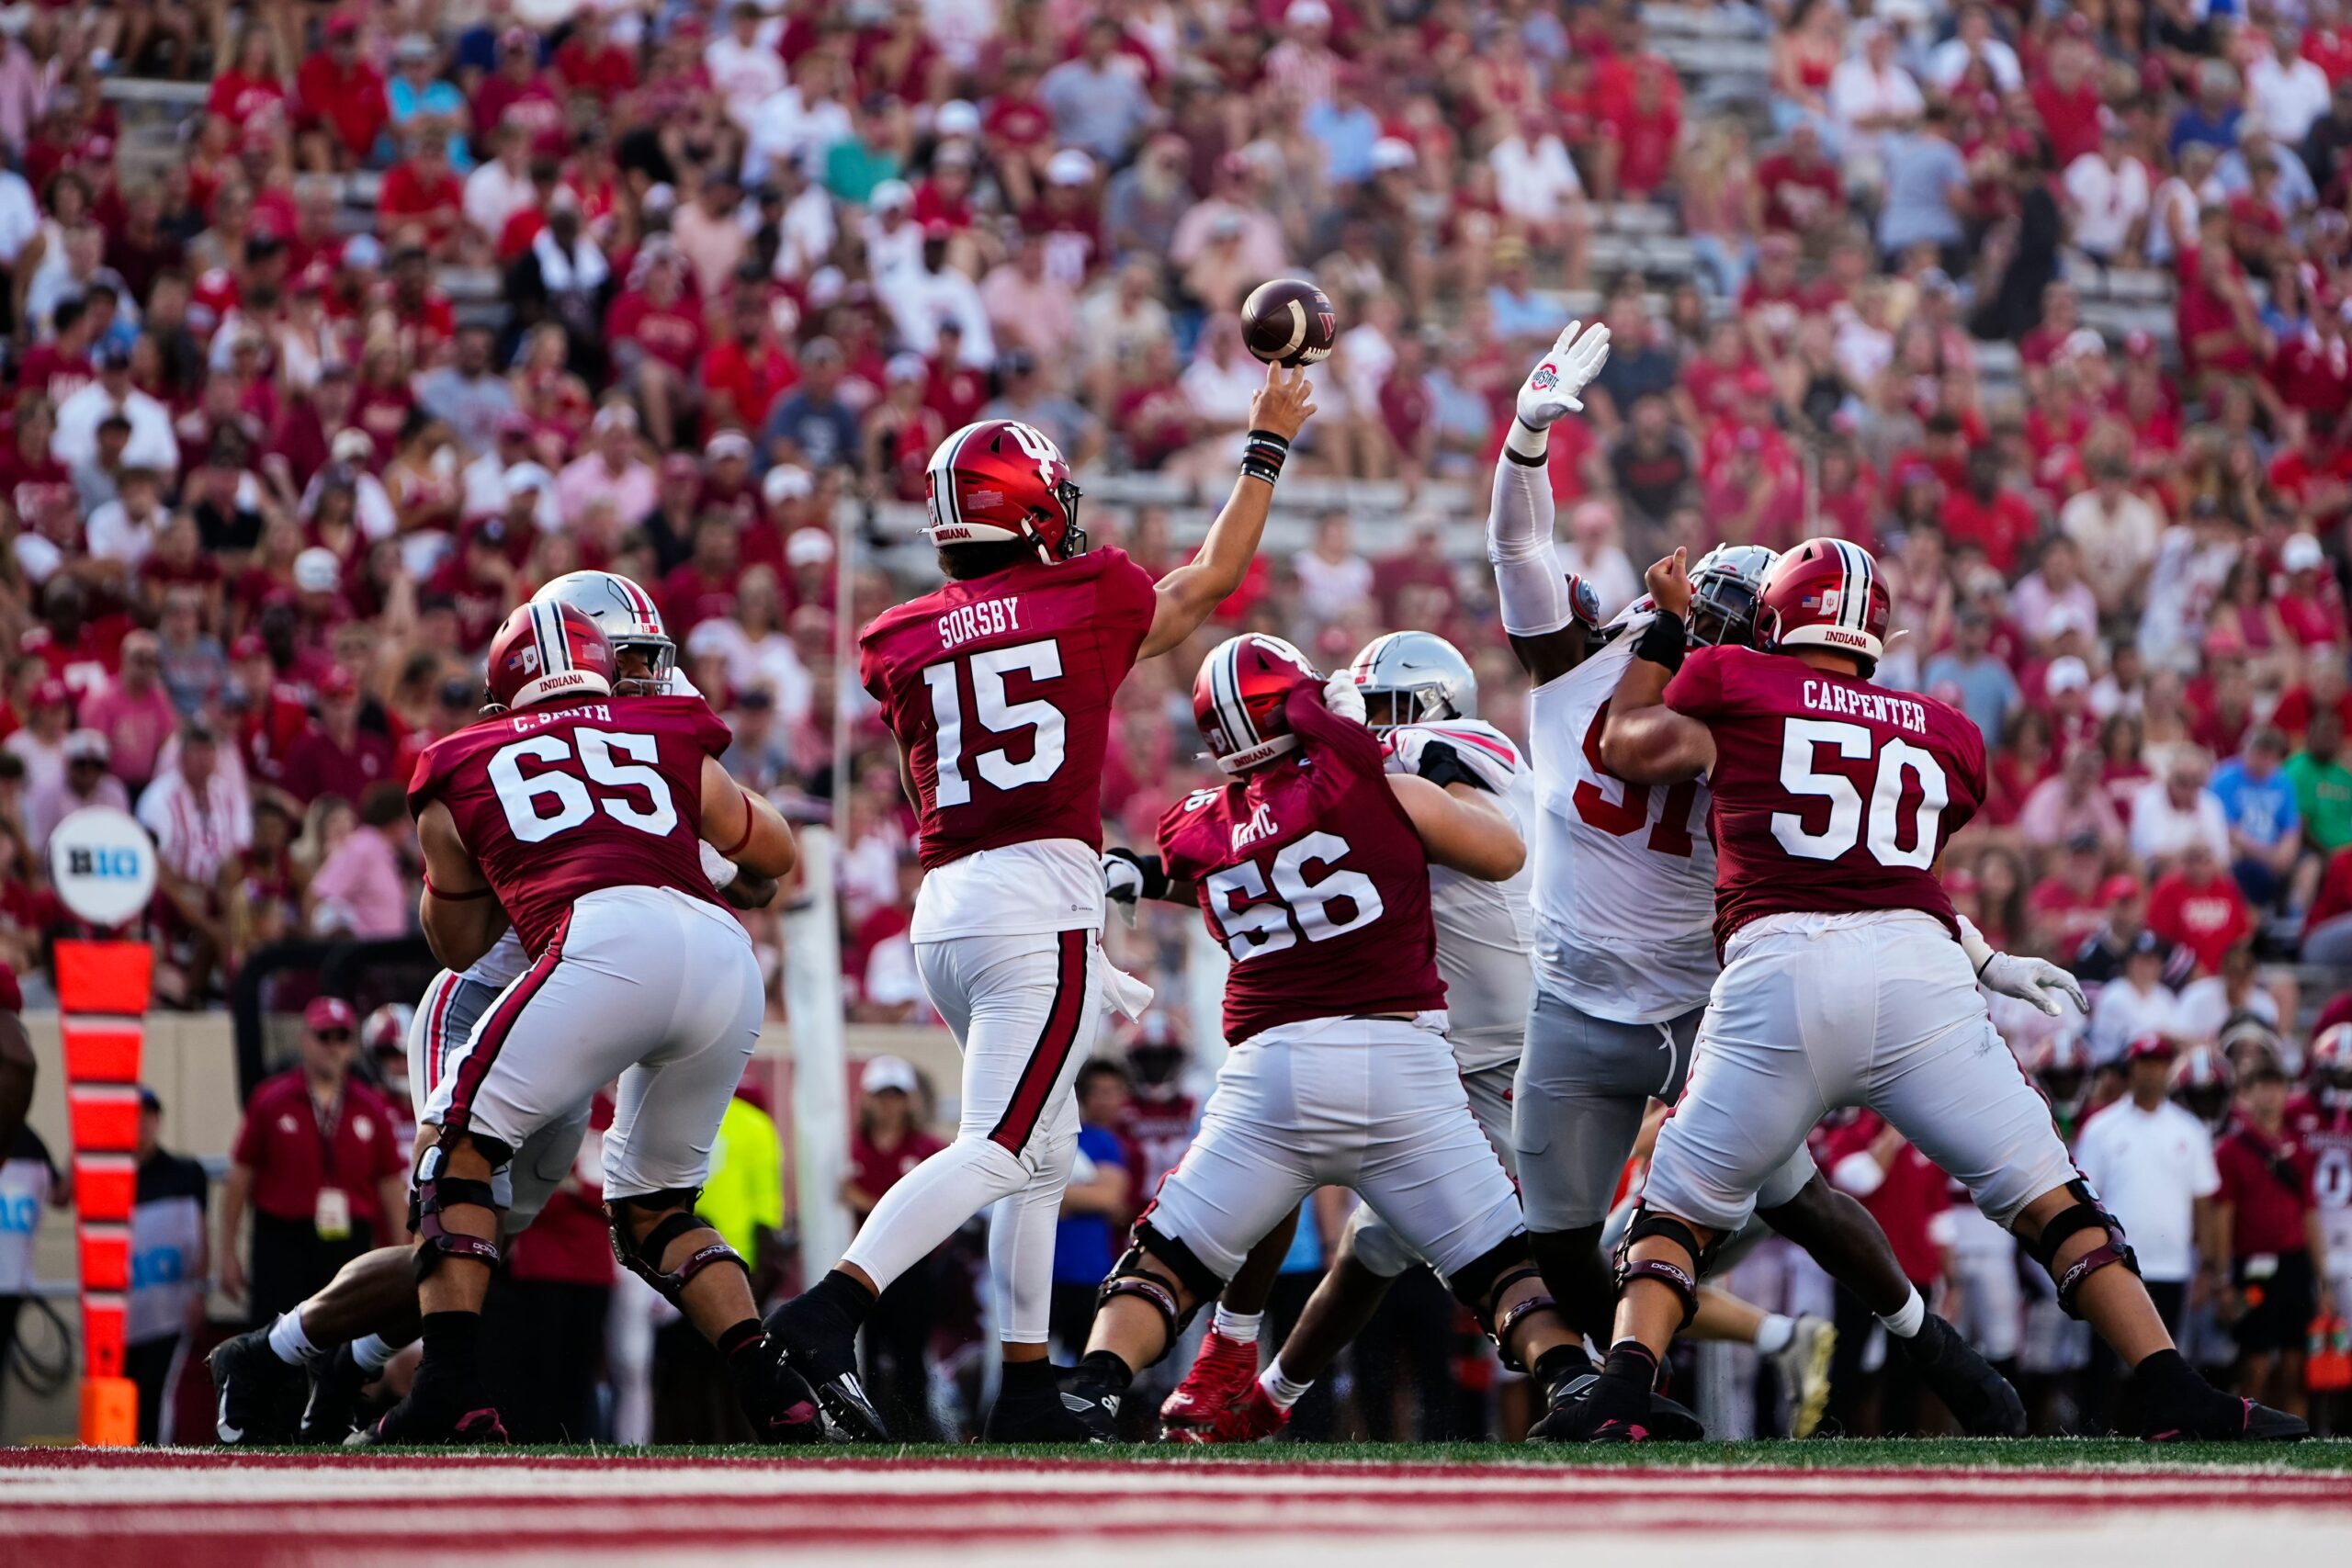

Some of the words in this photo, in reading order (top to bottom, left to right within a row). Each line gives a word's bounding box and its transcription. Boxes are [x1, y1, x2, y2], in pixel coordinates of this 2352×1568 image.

[935, 527, 972, 542] INDIANA
[938, 596, 1021, 649] SORSBY
[1825, 630, 1868, 649] INDIANA
[539, 673, 585, 693] INDIANA
[1803, 679, 1928, 735] CARPENTER
[922, 638, 1067, 809] 15
[1232, 746, 1276, 768] INDIANA
[486, 726, 679, 843] 65
[1770, 716, 1950, 872] 50
[1205, 830, 1385, 963] 56
